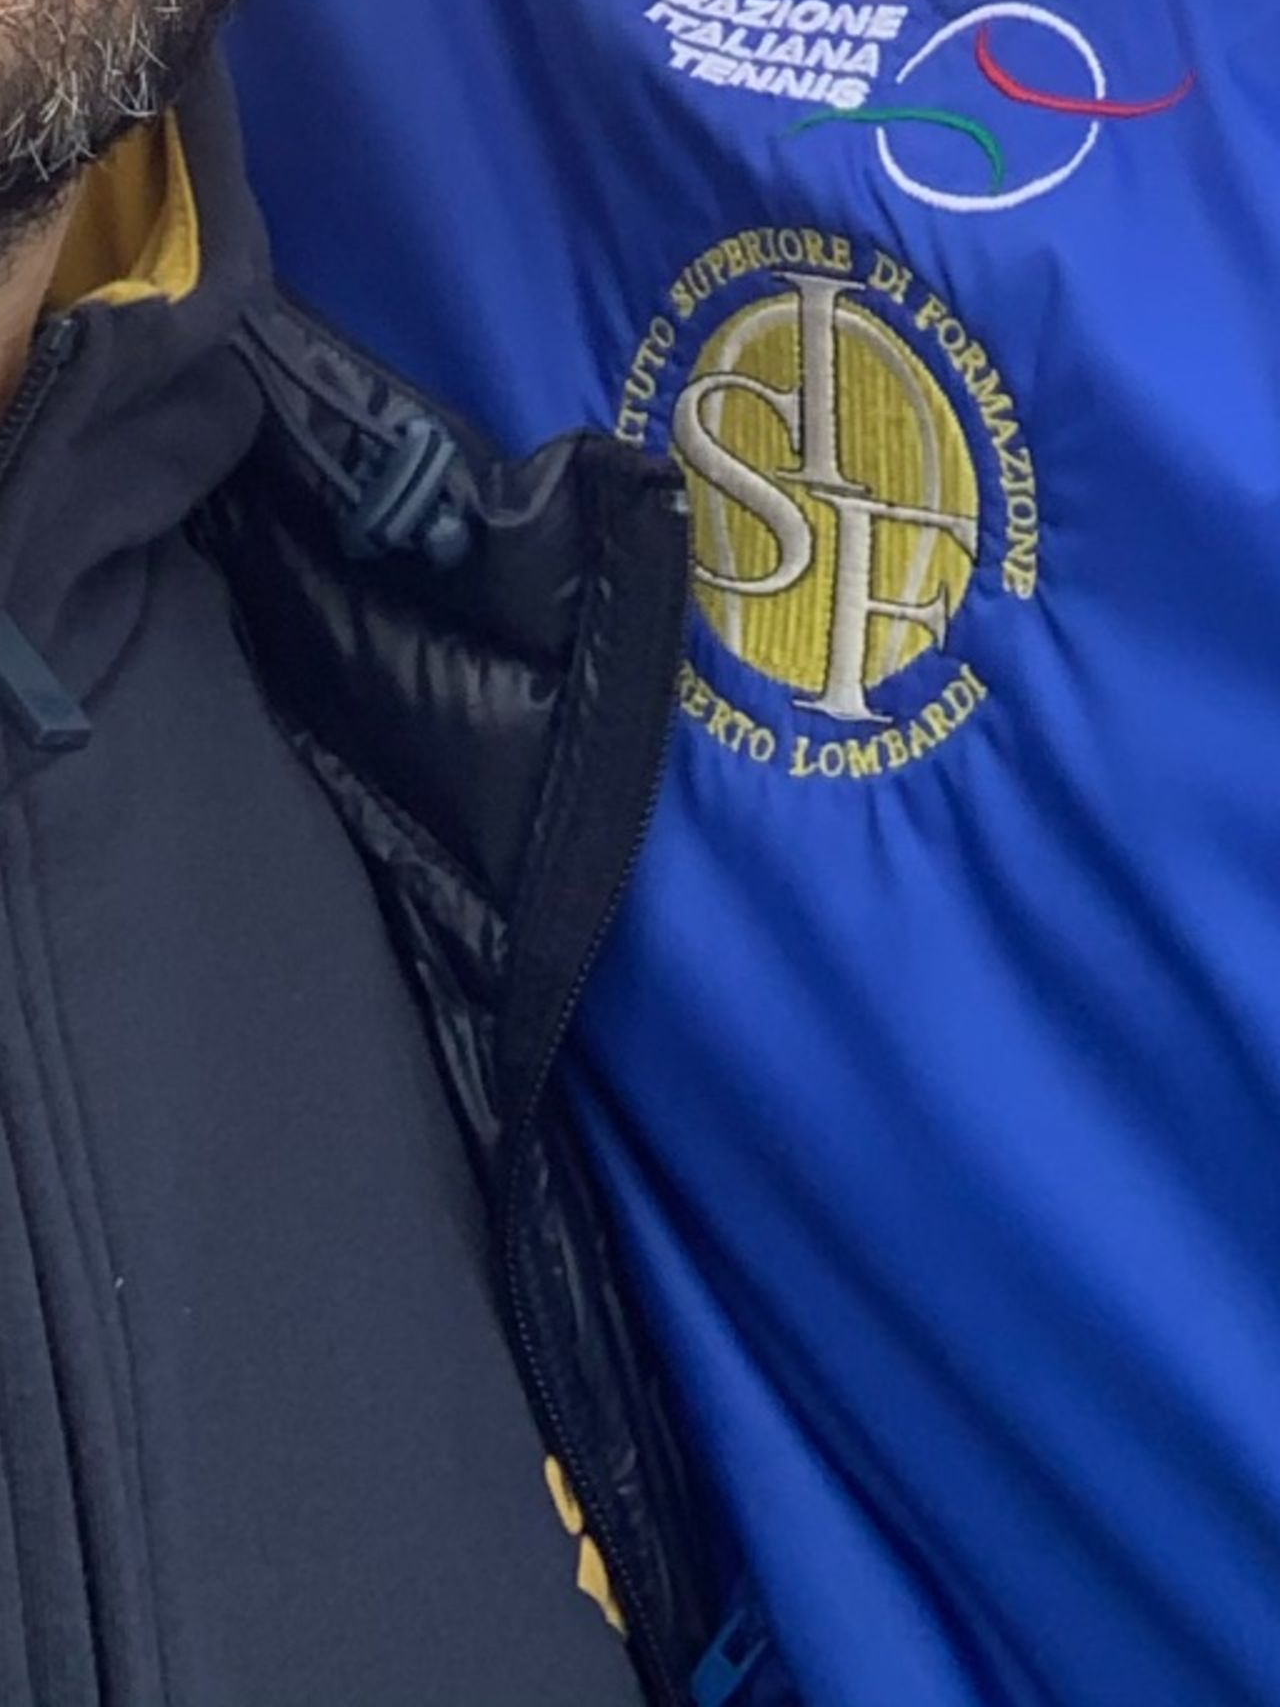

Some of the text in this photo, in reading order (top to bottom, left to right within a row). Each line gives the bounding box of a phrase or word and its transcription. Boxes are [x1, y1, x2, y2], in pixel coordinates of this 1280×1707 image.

[645, 1, 881, 78] ITALIANA
[668, 40, 871, 110] TENNIS
[671, 228, 853, 319] SUPERIORE
[917, 293, 1037, 600] FORMAZIONE
[788, 664, 989, 779] LOMBARDI
